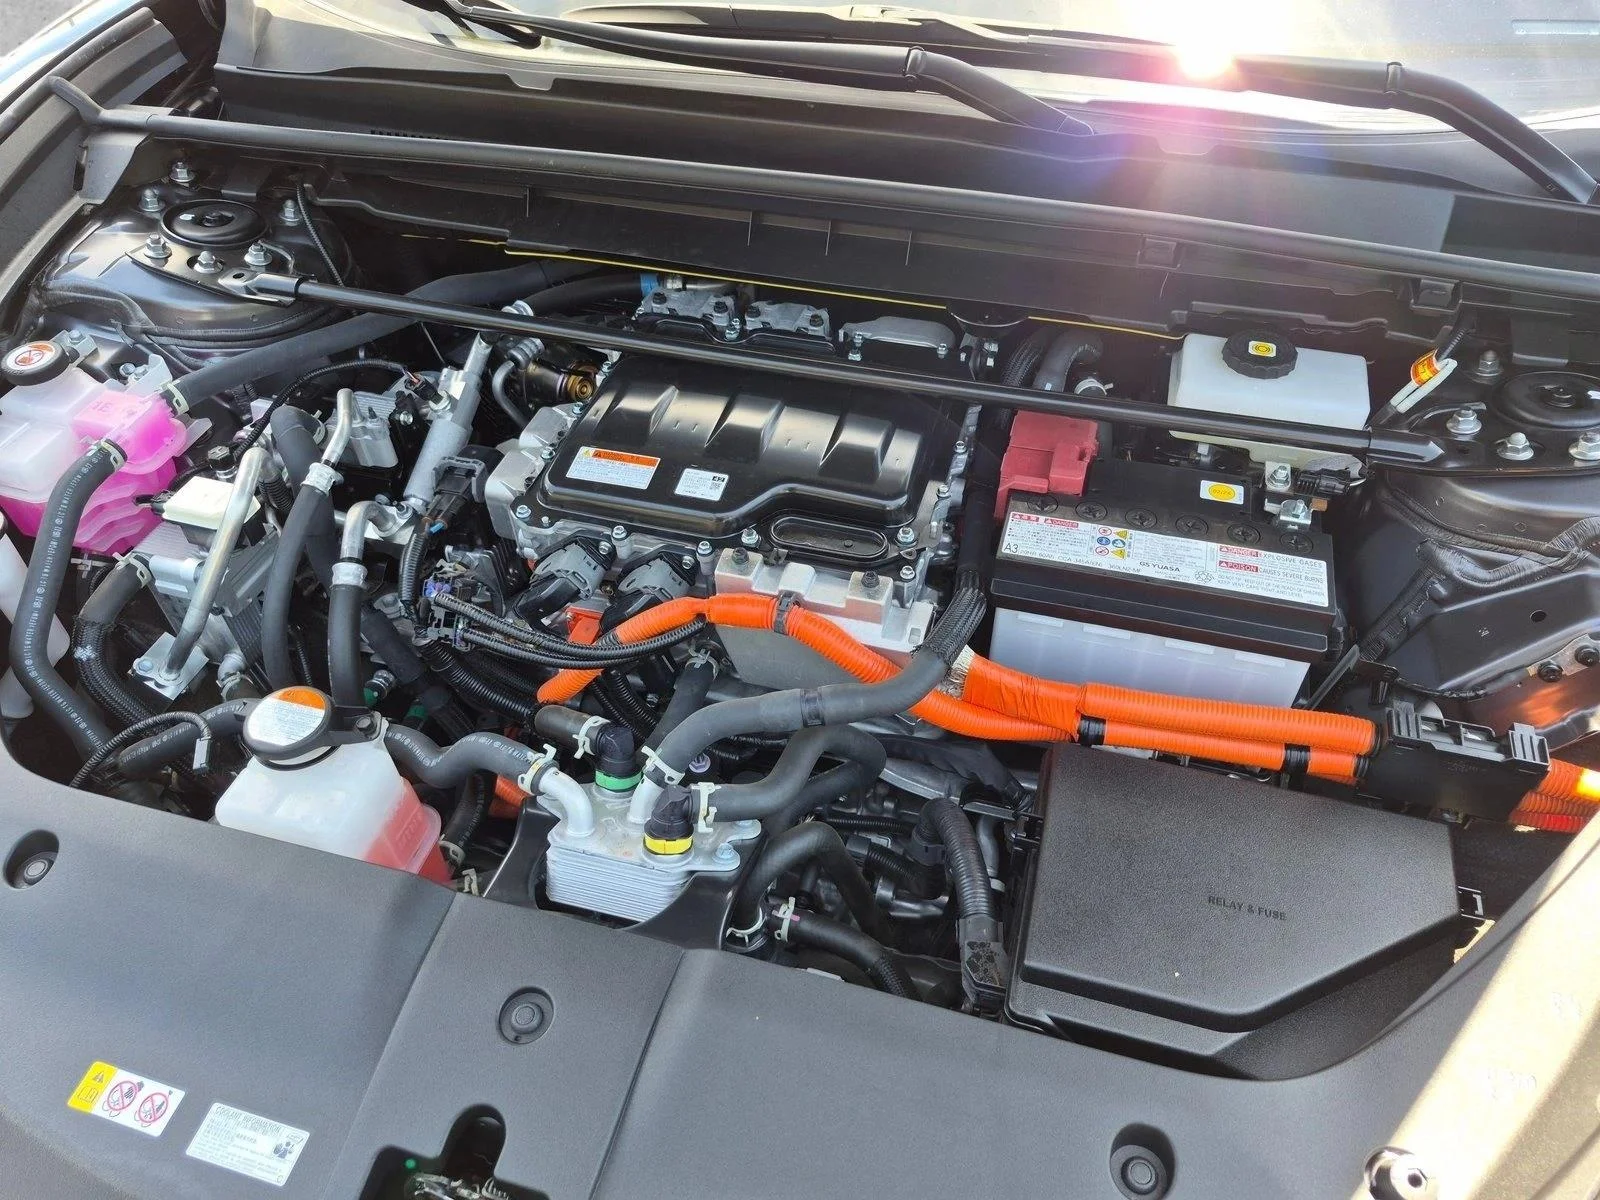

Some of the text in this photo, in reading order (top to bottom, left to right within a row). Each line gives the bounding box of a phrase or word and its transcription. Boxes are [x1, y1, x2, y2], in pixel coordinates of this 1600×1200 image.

[1004, 542, 1019, 553] A3
[1227, 547, 1322, 568] DANGER EXPLOSIVE GASES
[1151, 563, 1180, 572] YUASA
[1227, 561, 1257, 572] POISON
[1259, 567, 1281, 577] CAUSES
[1282, 571, 1302, 580] SEVERE
[1304, 575, 1323, 584] BURNS
[1208, 895, 1287, 921] RELAY & FUSE
